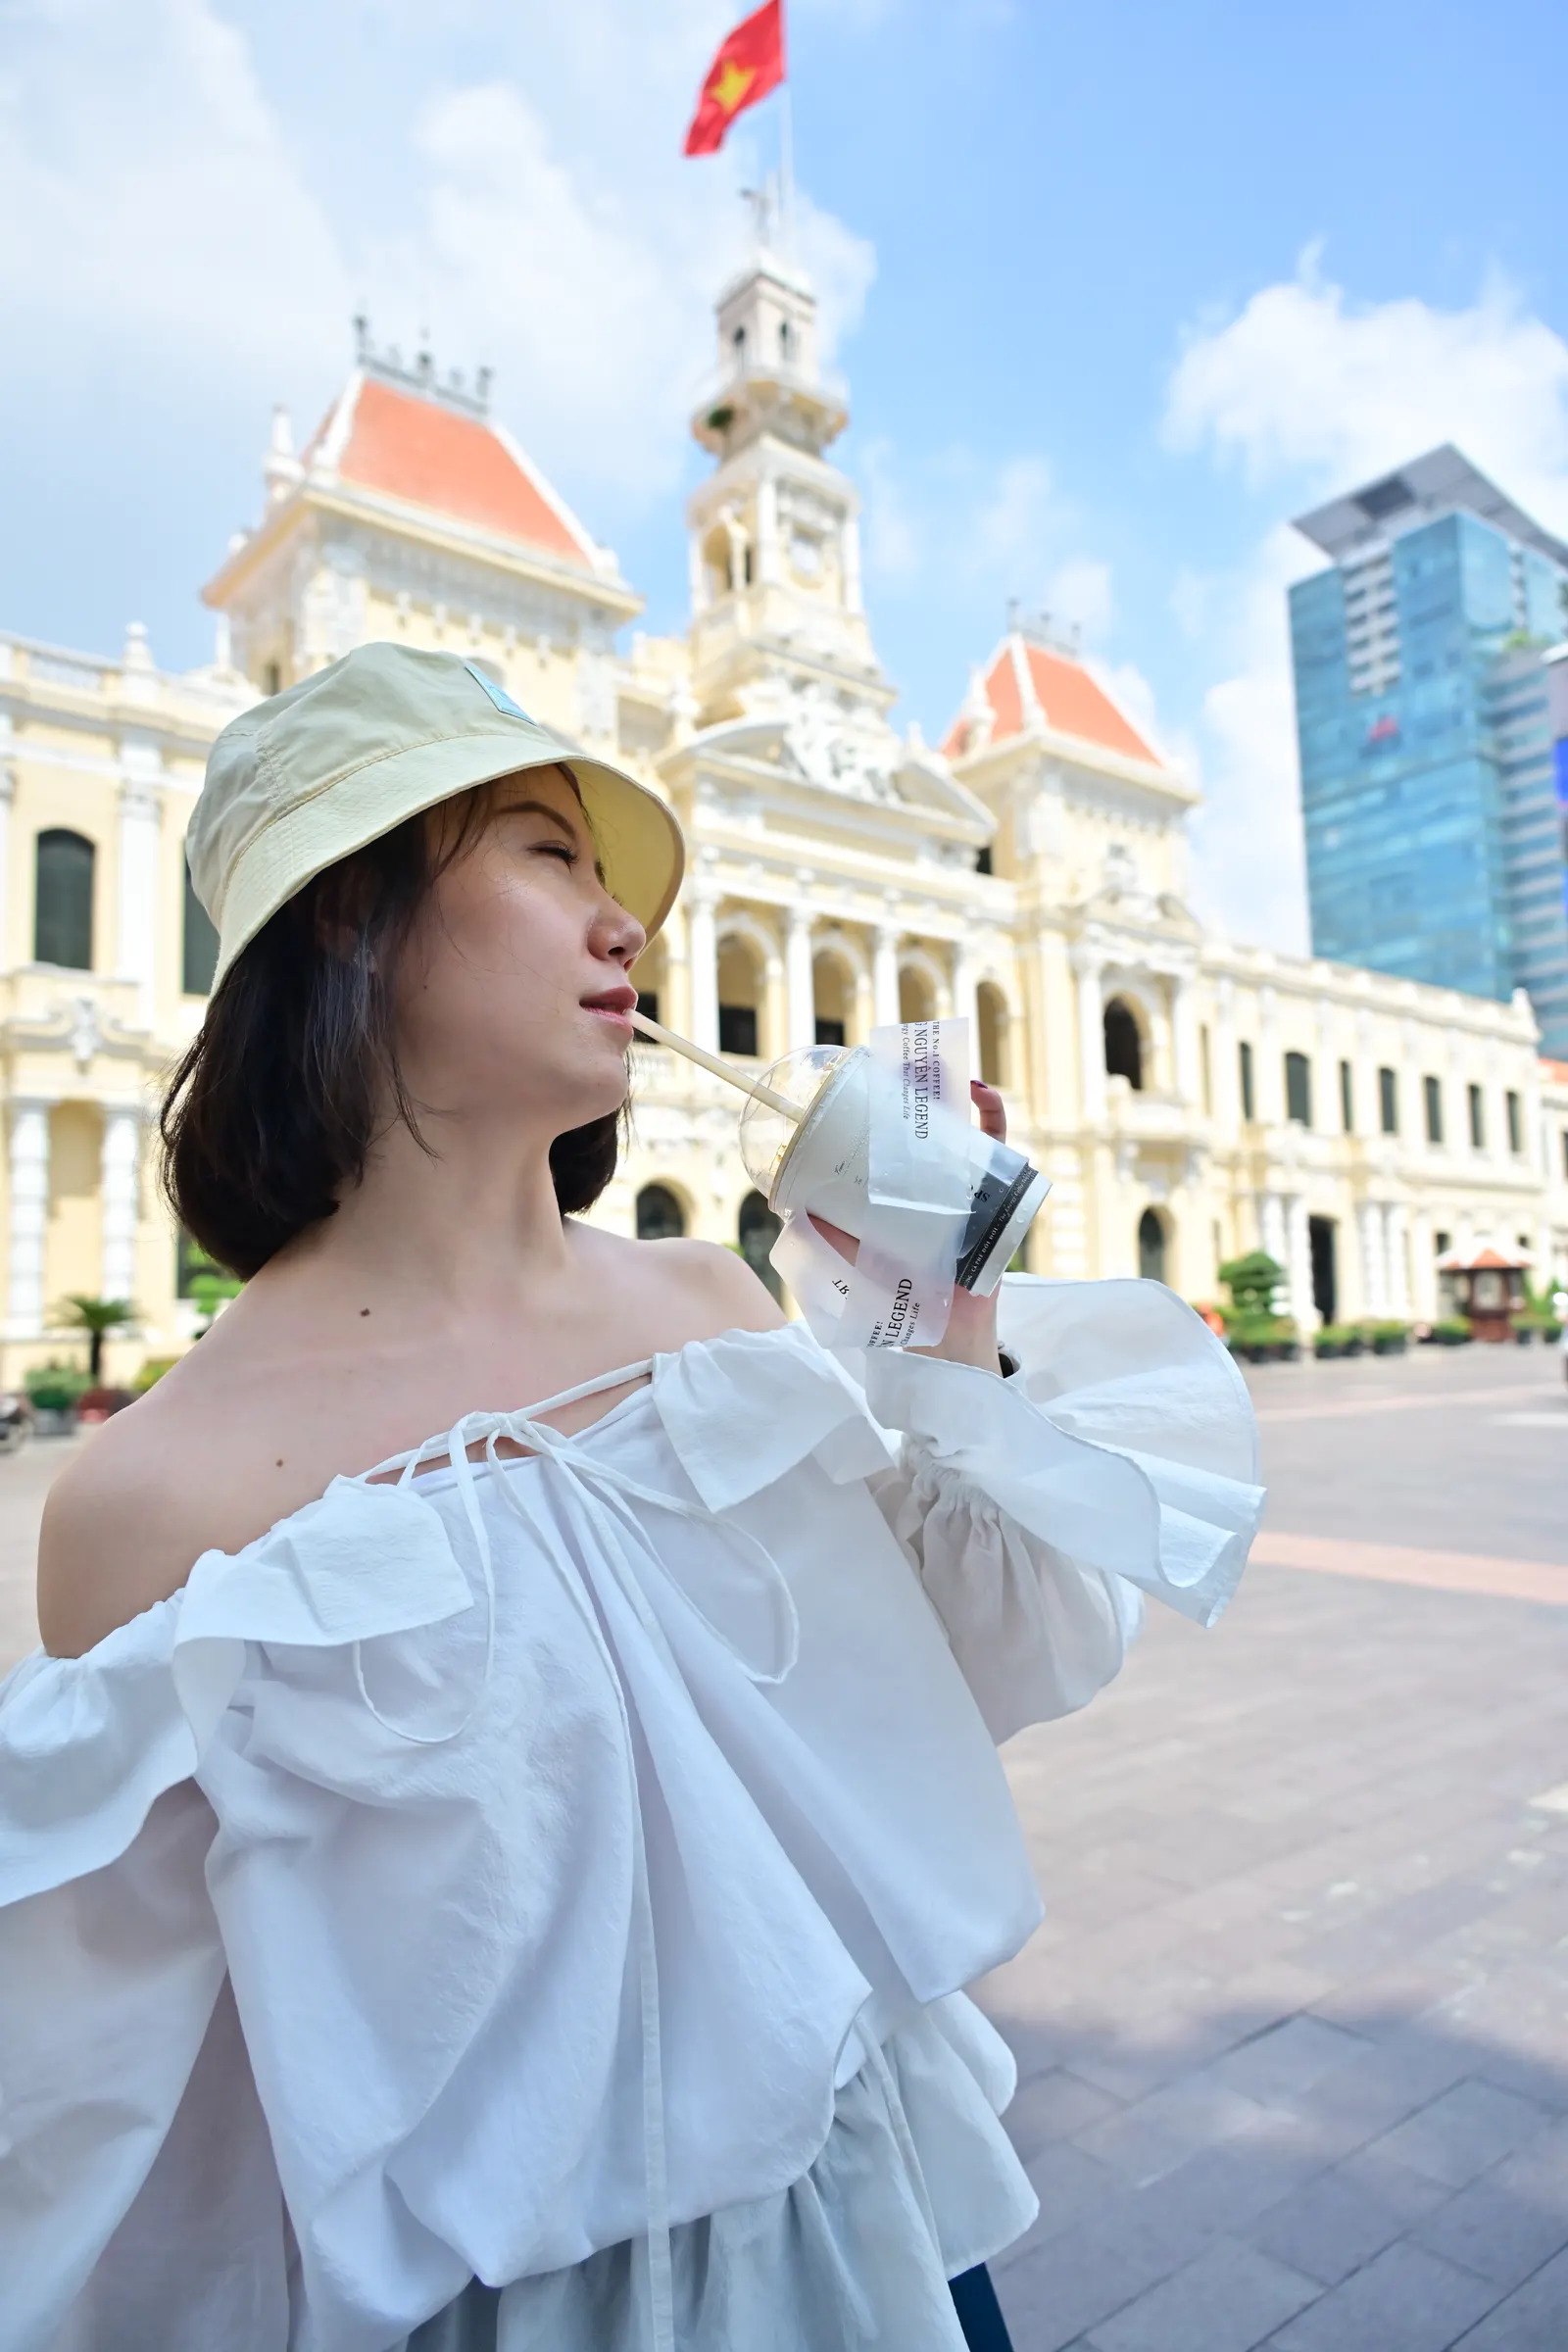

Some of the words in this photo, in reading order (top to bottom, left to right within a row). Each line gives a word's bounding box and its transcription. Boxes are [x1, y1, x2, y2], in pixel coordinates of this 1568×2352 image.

[902, 1037, 910, 1059] Coffee
[913, 1029, 931, 1083] NGUYÊN
[902, 1078, 911, 1103] Changes
[932, 1060, 941, 1100] COFFEE!
[914, 1087, 929, 1139] LEGEND
[884, 1278, 912, 1338] LEGEND
[909, 1302, 920, 1320] Life
[866, 1321, 883, 1348] OFFEE!
